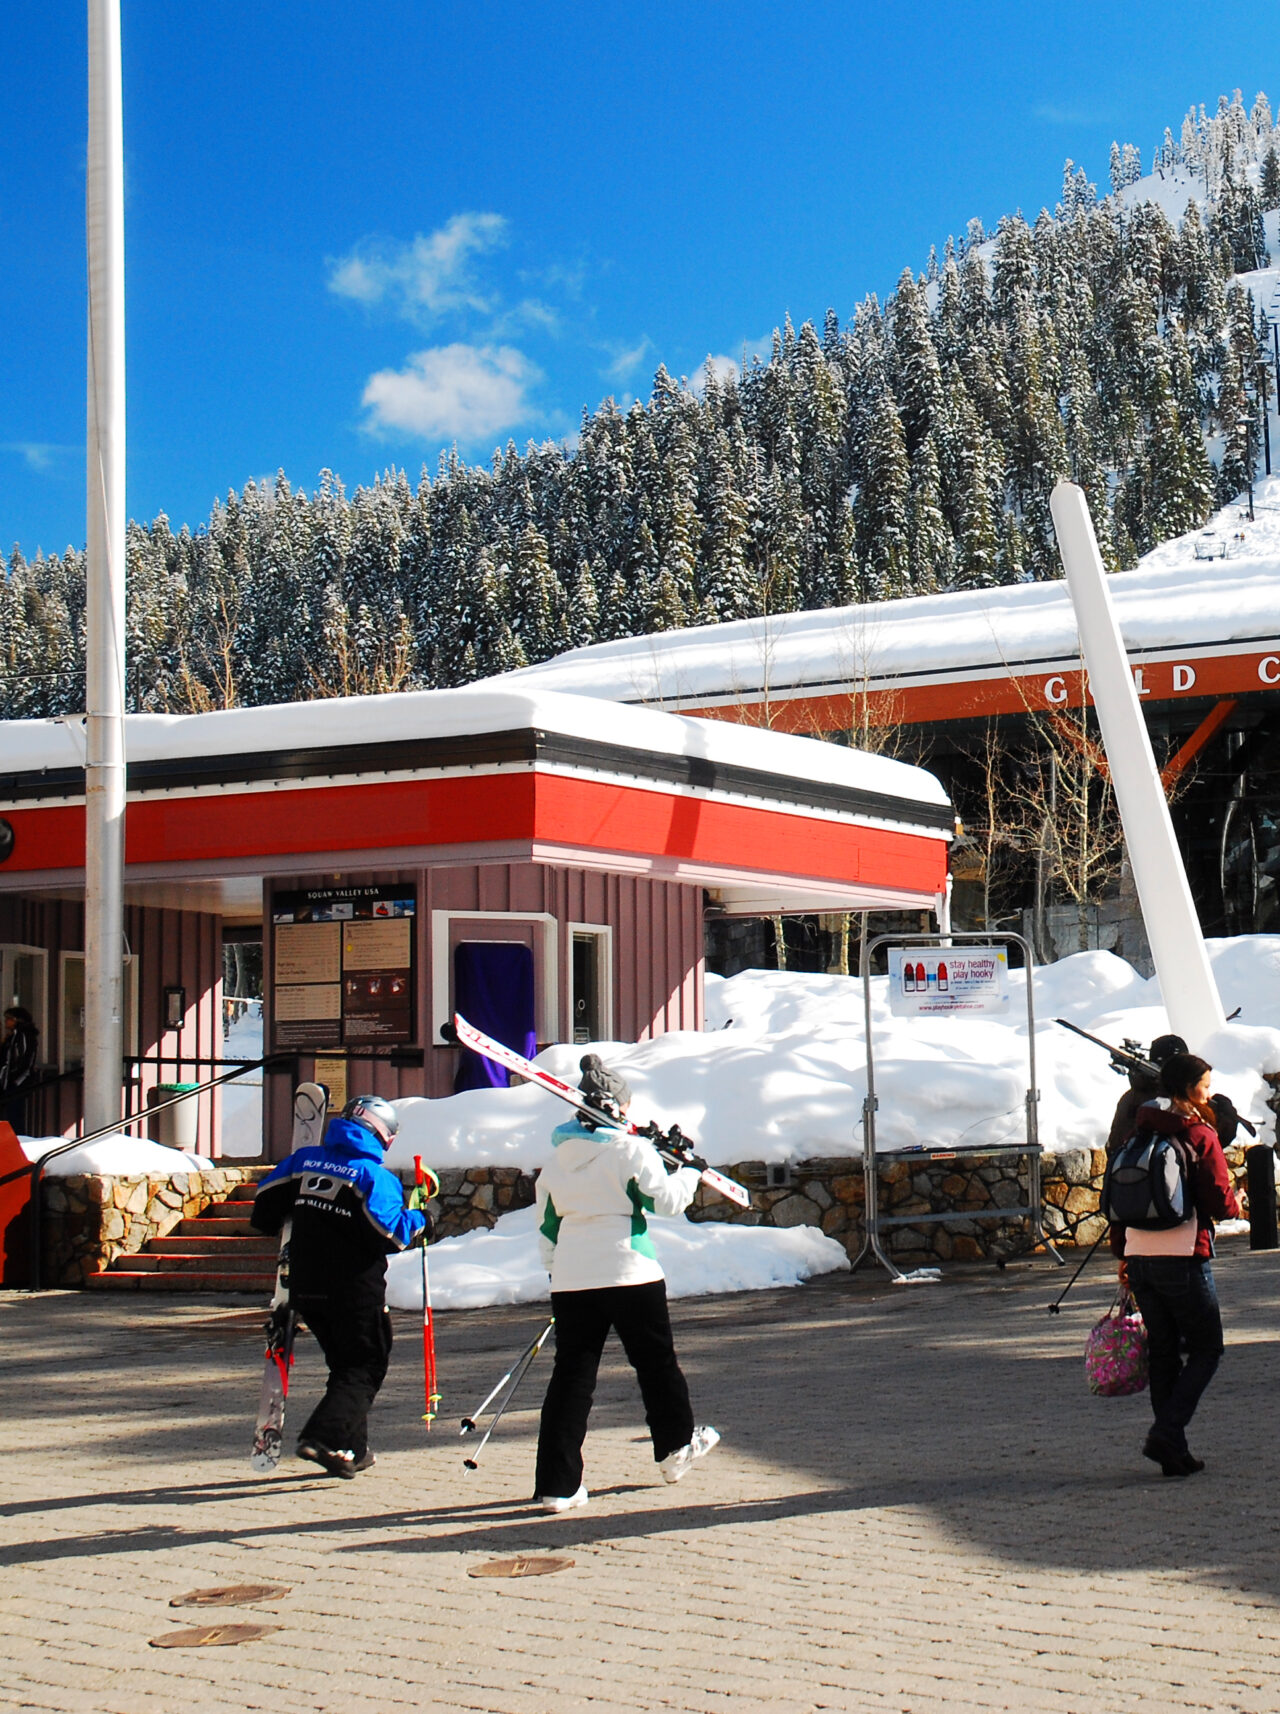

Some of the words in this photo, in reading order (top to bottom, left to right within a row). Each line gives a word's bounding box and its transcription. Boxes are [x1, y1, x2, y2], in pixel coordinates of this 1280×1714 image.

[1044, 664, 1197, 703] GLD
[307, 890, 333, 899] SQUAW
[335, 889, 362, 897] VALLEY
[950, 960, 966, 970] stay
[968, 959, 995, 969] healthy
[953, 970, 968, 980] play
[971, 969, 994, 979] hooky
[303, 1160, 321, 1168] NOW
[323, 1162, 358, 1177] SPORTS
[307, 1199, 333, 1211] VALLEY
[335, 1207, 352, 1217] USA
